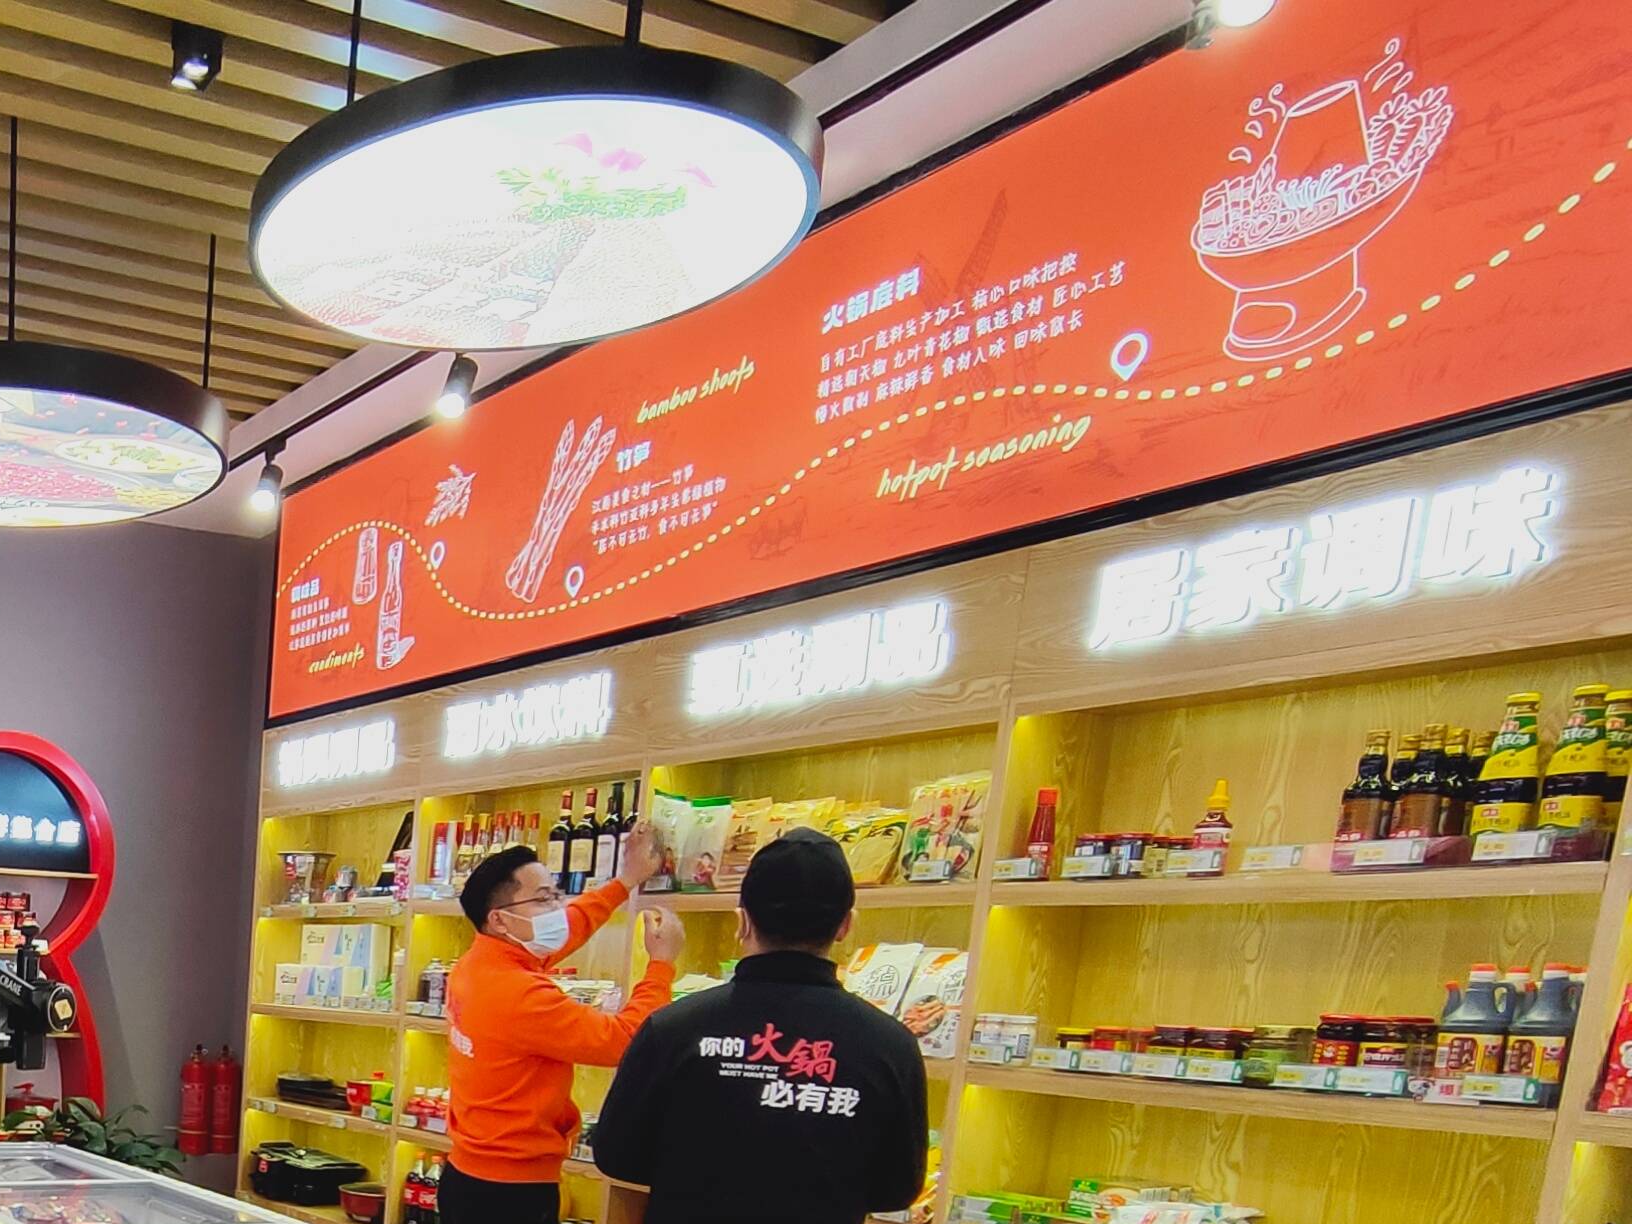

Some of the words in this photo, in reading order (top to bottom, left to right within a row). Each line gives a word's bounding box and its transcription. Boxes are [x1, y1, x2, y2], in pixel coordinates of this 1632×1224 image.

[637, 383, 696, 424] bamboo
[876, 447, 959, 502] hotpot
[961, 413, 1092, 473] seasoning
[1089, 468, 1561, 649] 居家调味
[0, 974, 23, 997] CRANE
[760, 1079, 861, 1118] 必有我
